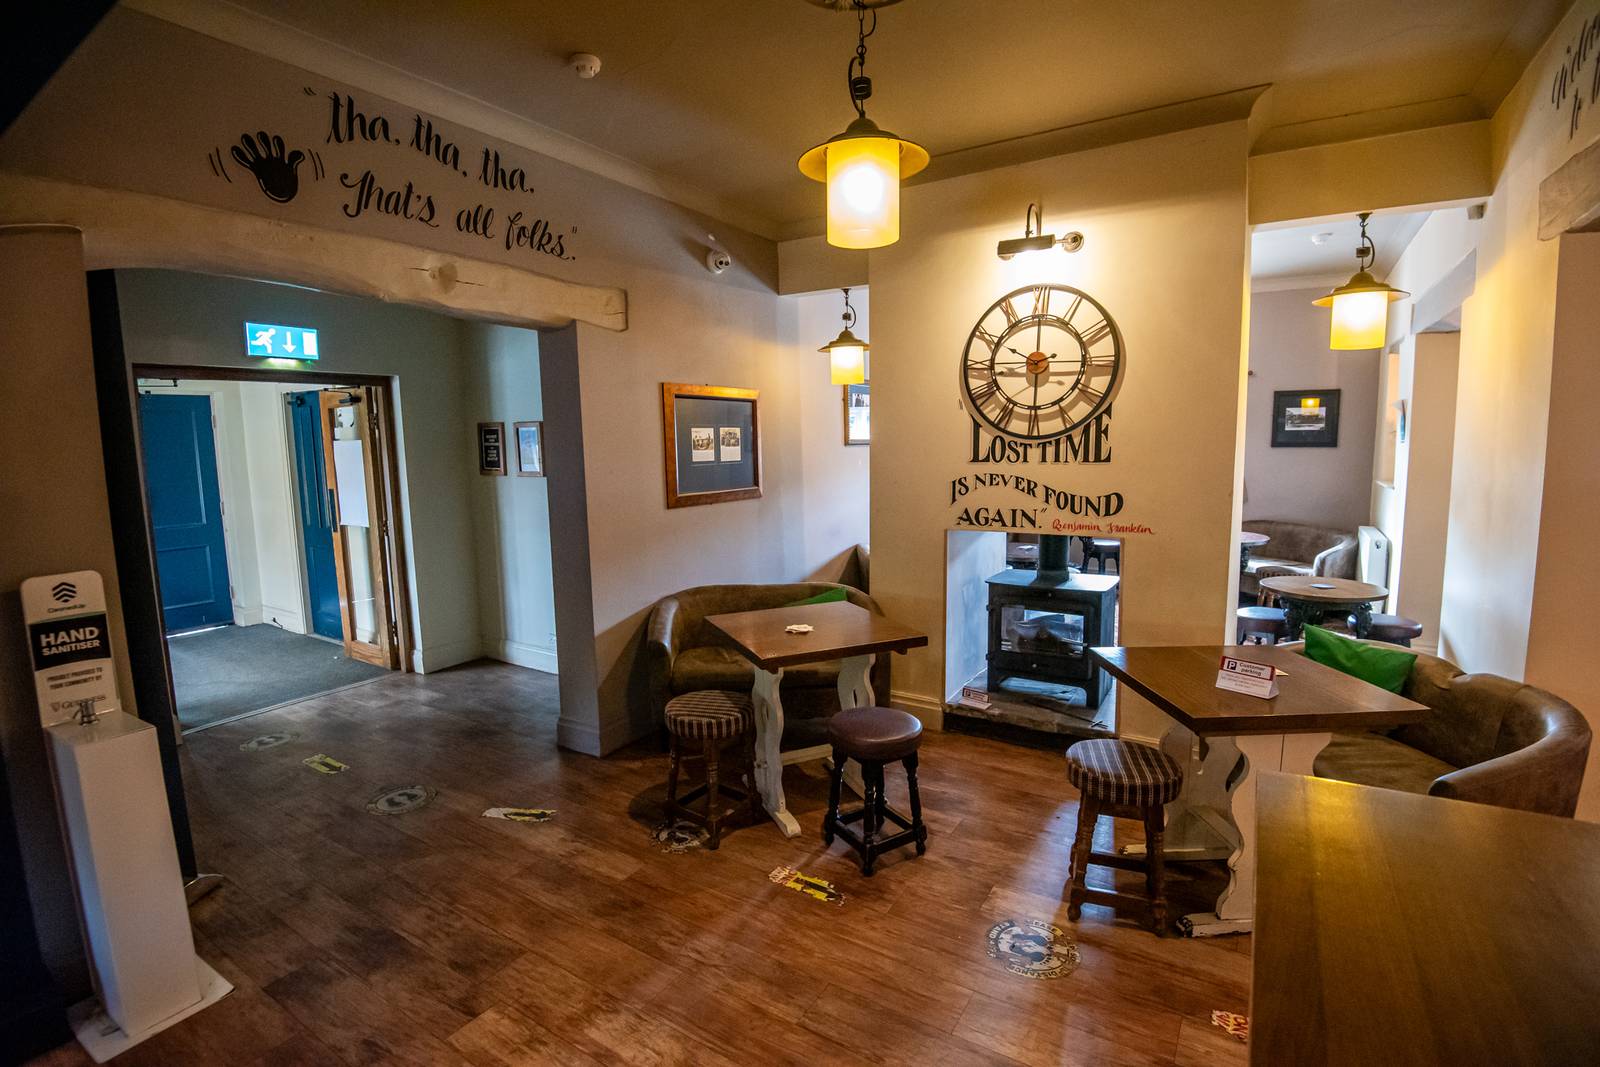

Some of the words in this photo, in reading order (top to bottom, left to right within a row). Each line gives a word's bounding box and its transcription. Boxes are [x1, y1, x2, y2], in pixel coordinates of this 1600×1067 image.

[340, 170, 439, 228] That's
[456, 204, 495, 238] all
[969, 415, 1032, 464] LOST
[1037, 402, 1113, 464] TIME
[974, 473, 1038, 498] NEVER
[1042, 485, 1124, 517] FOUND
[1052, 518, 1102, 533] Benjamin
[1107, 522, 1156, 535] Franklin
[40, 627, 100, 647] HAND
[42, 640, 101, 656] SANITISER
[1240, 662, 1266, 671] Customer
[1241, 668, 1262, 677] parking
